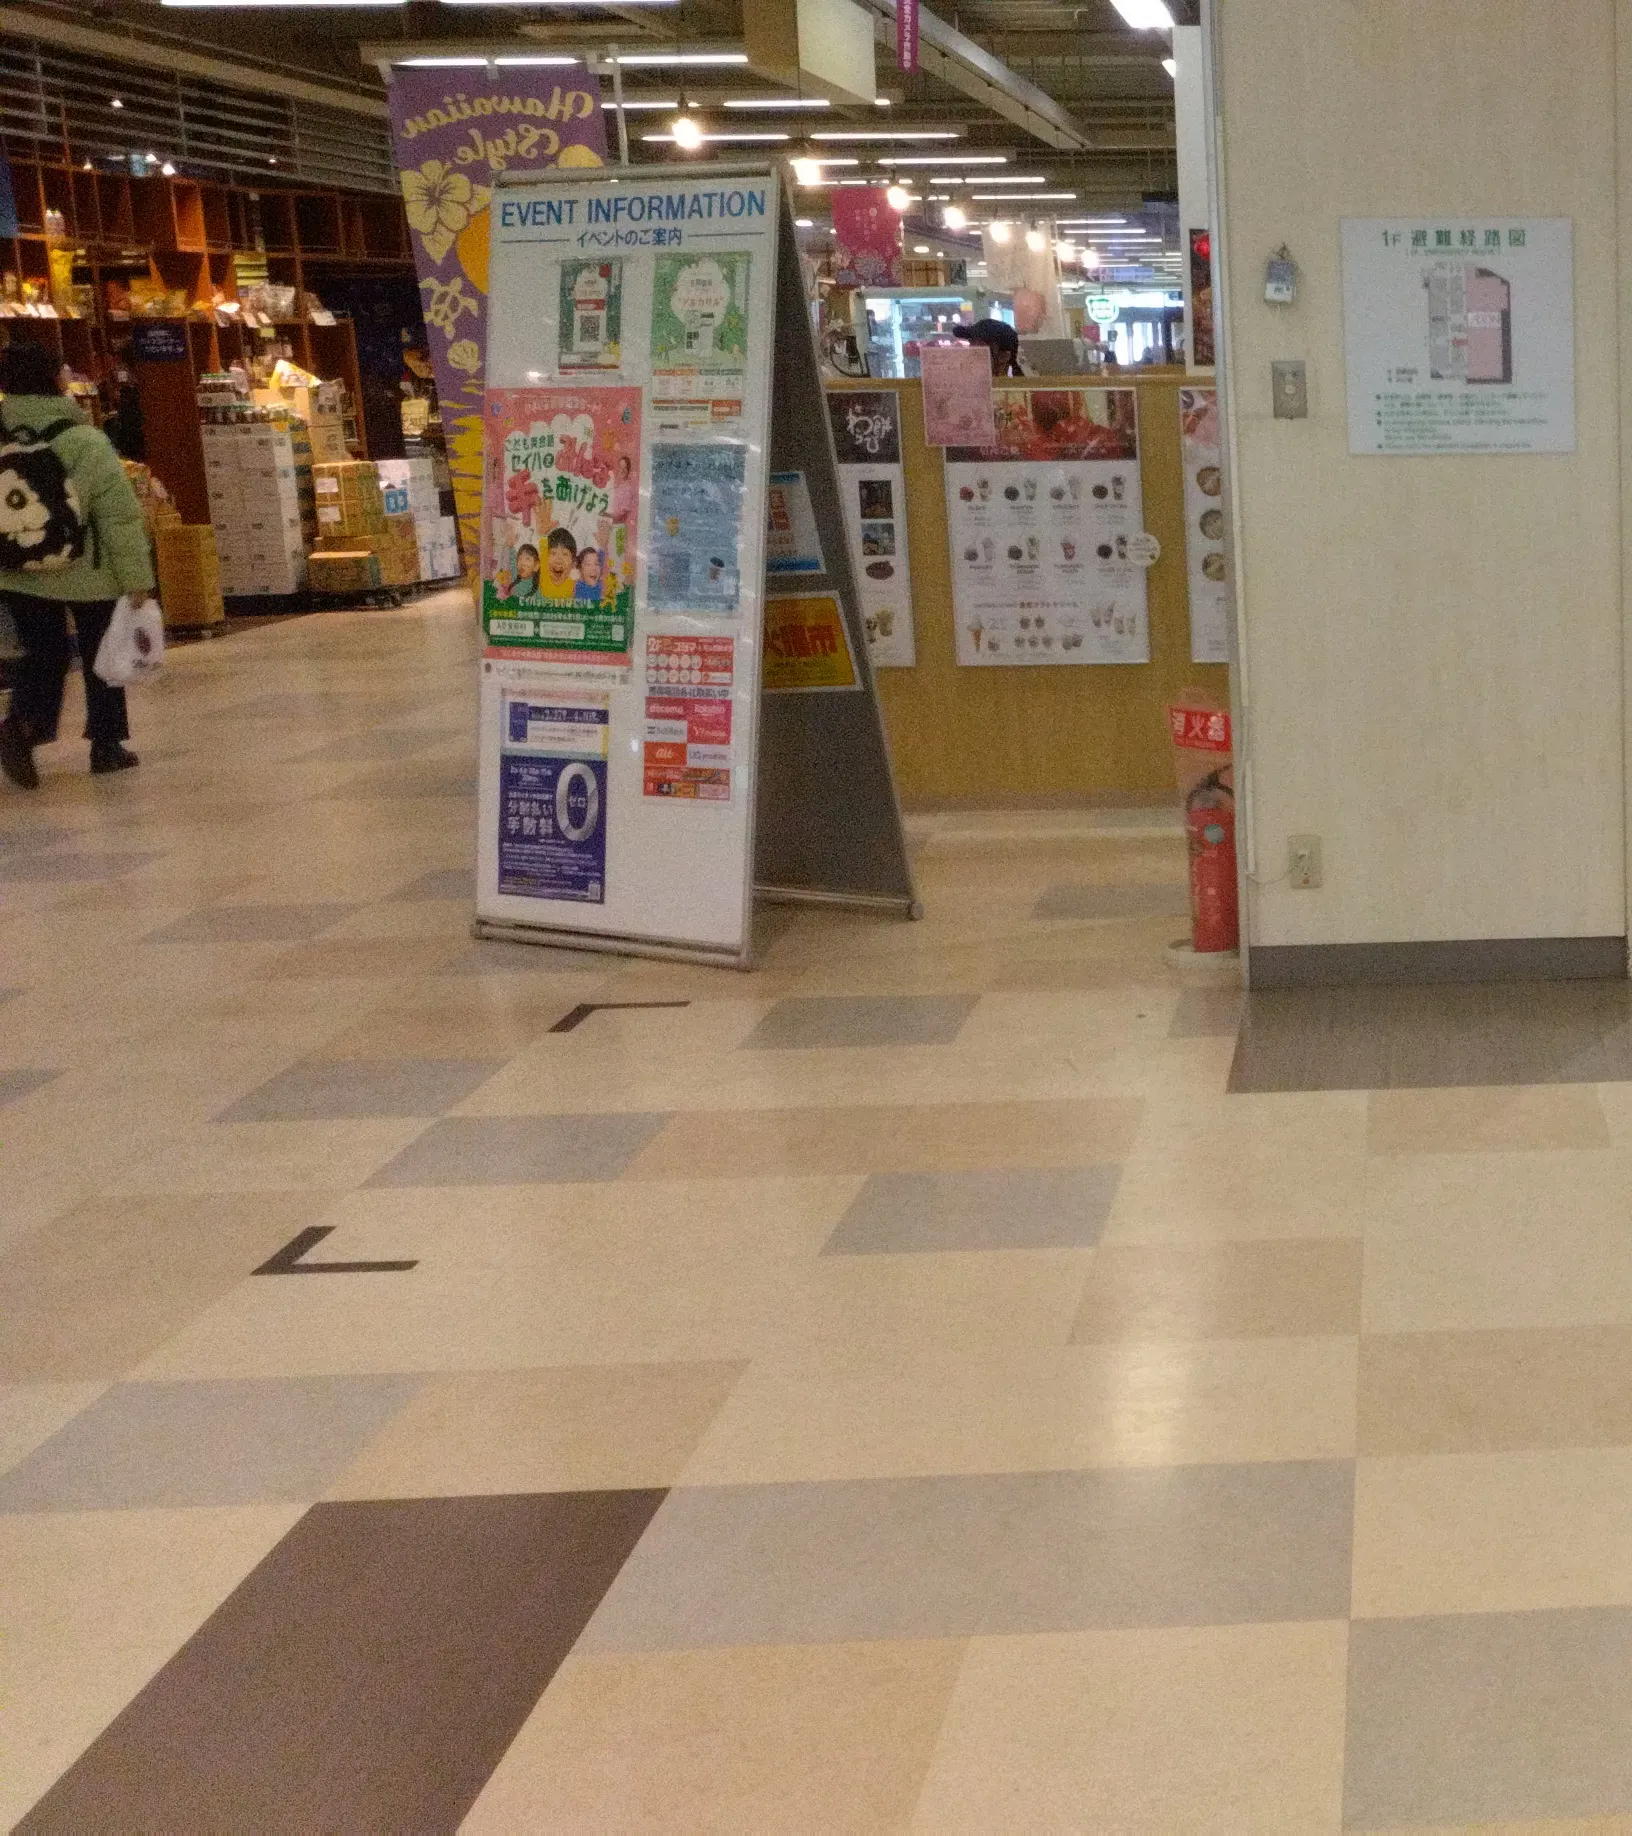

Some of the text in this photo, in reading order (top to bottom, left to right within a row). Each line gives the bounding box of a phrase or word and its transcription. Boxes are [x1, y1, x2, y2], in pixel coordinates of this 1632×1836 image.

[501, 189, 766, 227] EVENT INFORMATION
[577, 227, 683, 247] イベントのご案内
[1381, 229, 1401, 247] 1F
[1411, 228, 1527, 248] 避難経路図
